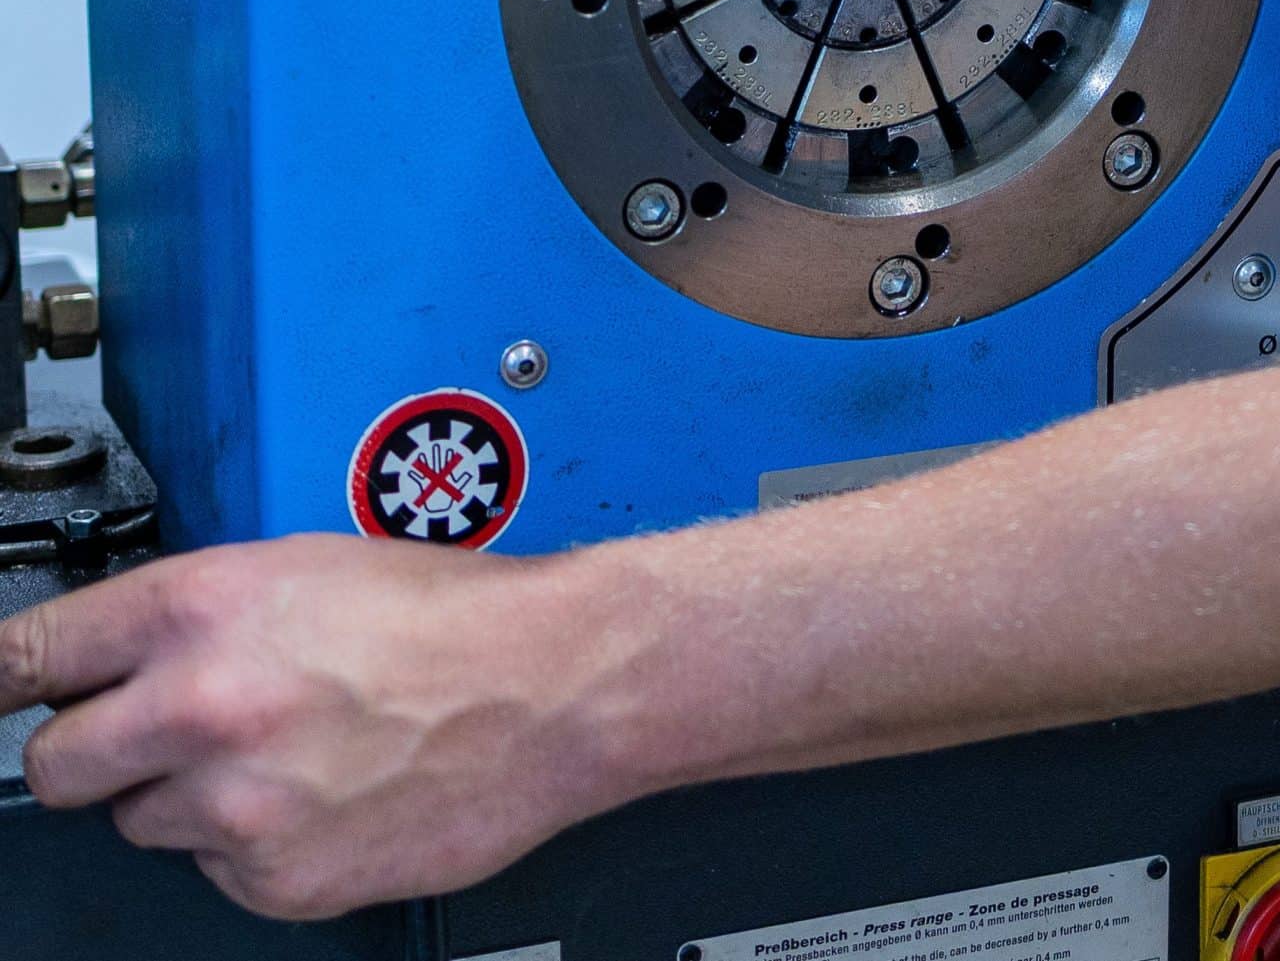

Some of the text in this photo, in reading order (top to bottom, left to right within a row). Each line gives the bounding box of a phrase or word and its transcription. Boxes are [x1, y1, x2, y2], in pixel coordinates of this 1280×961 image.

[755, 928, 848, 957] Preßbereich
[863, 920, 905, 937] Press
[910, 911, 953, 928] range
[969, 902, 1006, 917] Zone
[1011, 897, 1028, 909] de
[1034, 884, 1099, 906] pressage
[925, 926, 949, 939] kann
[952, 923, 967, 934] um
[969, 918, 984, 930] 0,4
[987, 915, 1006, 926] mm
[1008, 903, 1076, 923] unterschritten
[1078, 895, 1114, 909] werden
[949, 946, 968, 957] can
[970, 943, 982, 953] be
[985, 932, 1034, 950] decreased
[1037, 930, 1048, 941] by
[1060, 921, 1092, 937] further
[1095, 918, 1109, 931] 0,4
[1112, 915, 1130, 926] mm
[1053, 949, 1071, 961] mm
